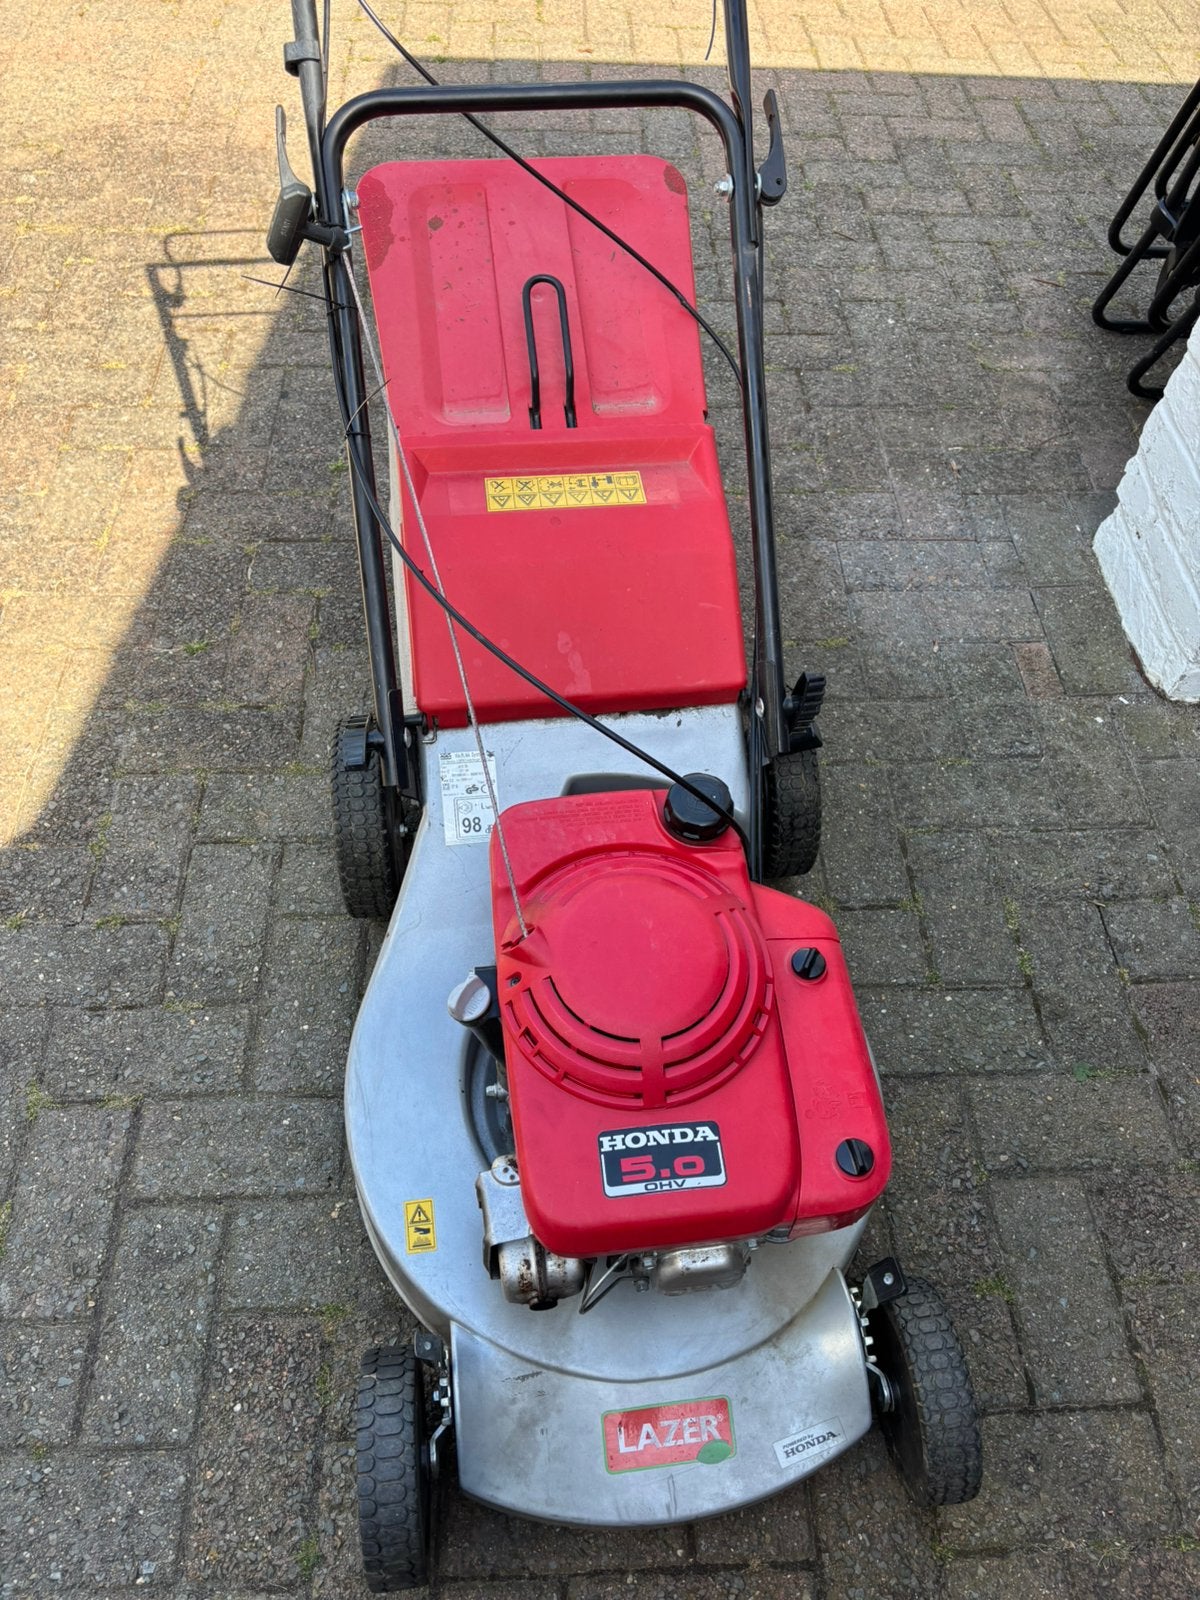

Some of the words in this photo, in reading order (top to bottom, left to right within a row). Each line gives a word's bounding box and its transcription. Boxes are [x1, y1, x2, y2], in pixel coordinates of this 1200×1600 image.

[462, 816, 482, 834] 98
[600, 1126, 719, 1152] HONDA
[620, 1155, 705, 1182] 5.0
[644, 1179, 686, 1191] OHV
[617, 1414, 722, 1453] LAZER
[782, 1434, 808, 1450] POWERED
[783, 1431, 838, 1458] HONDA
